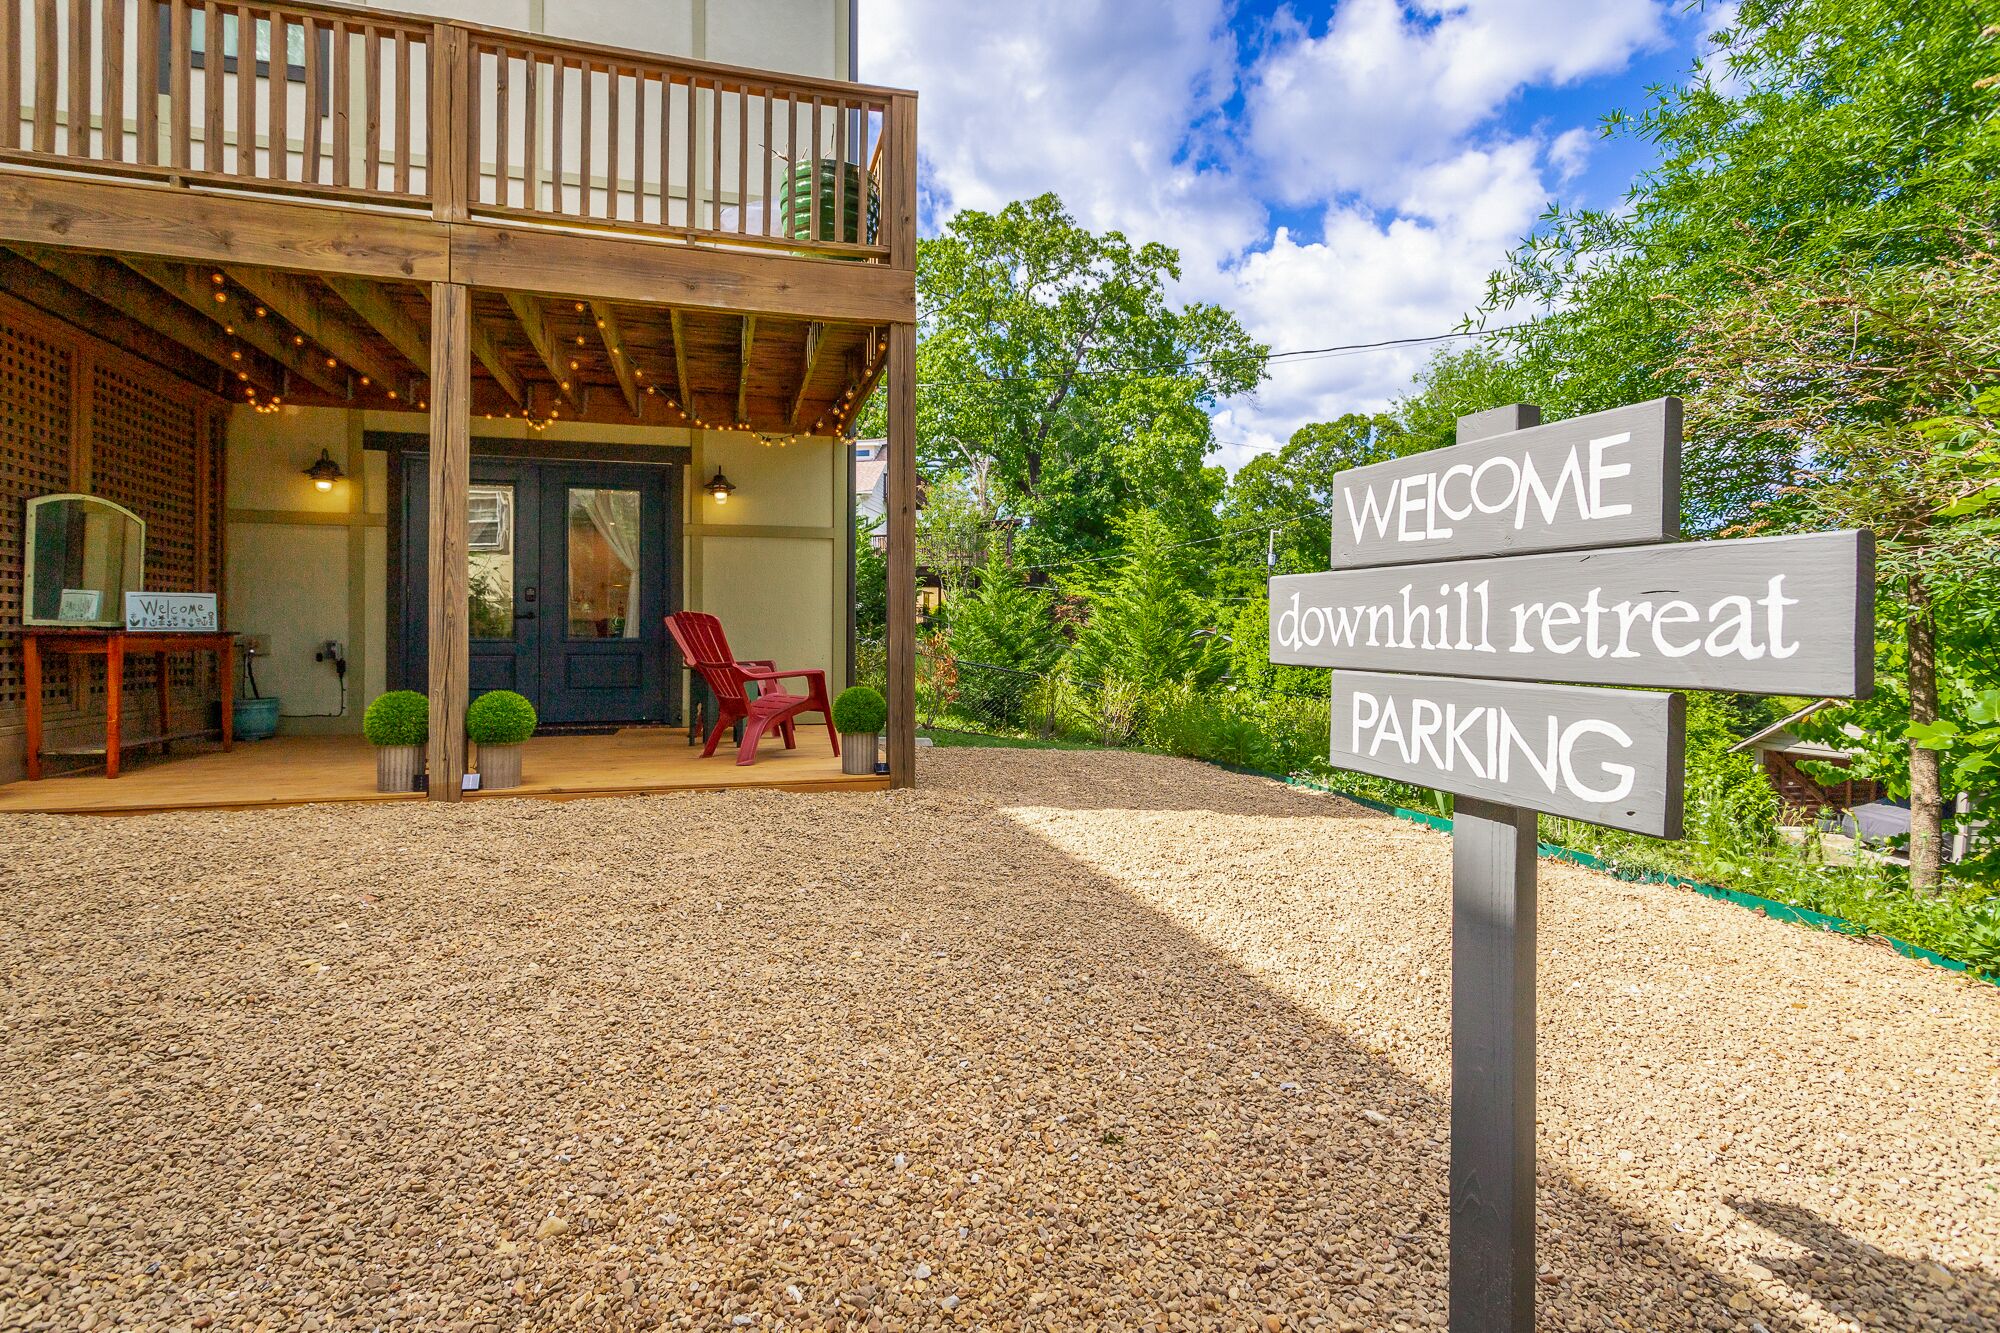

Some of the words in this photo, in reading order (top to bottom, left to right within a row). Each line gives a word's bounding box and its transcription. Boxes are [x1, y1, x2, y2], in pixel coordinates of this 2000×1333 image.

[1344, 431, 1633, 545] WELCOME
[139, 599, 205, 618] Welcome
[1277, 579, 1497, 654] downhill
[1509, 573, 1800, 661] retreat
[1351, 691, 1636, 803] PARKING
